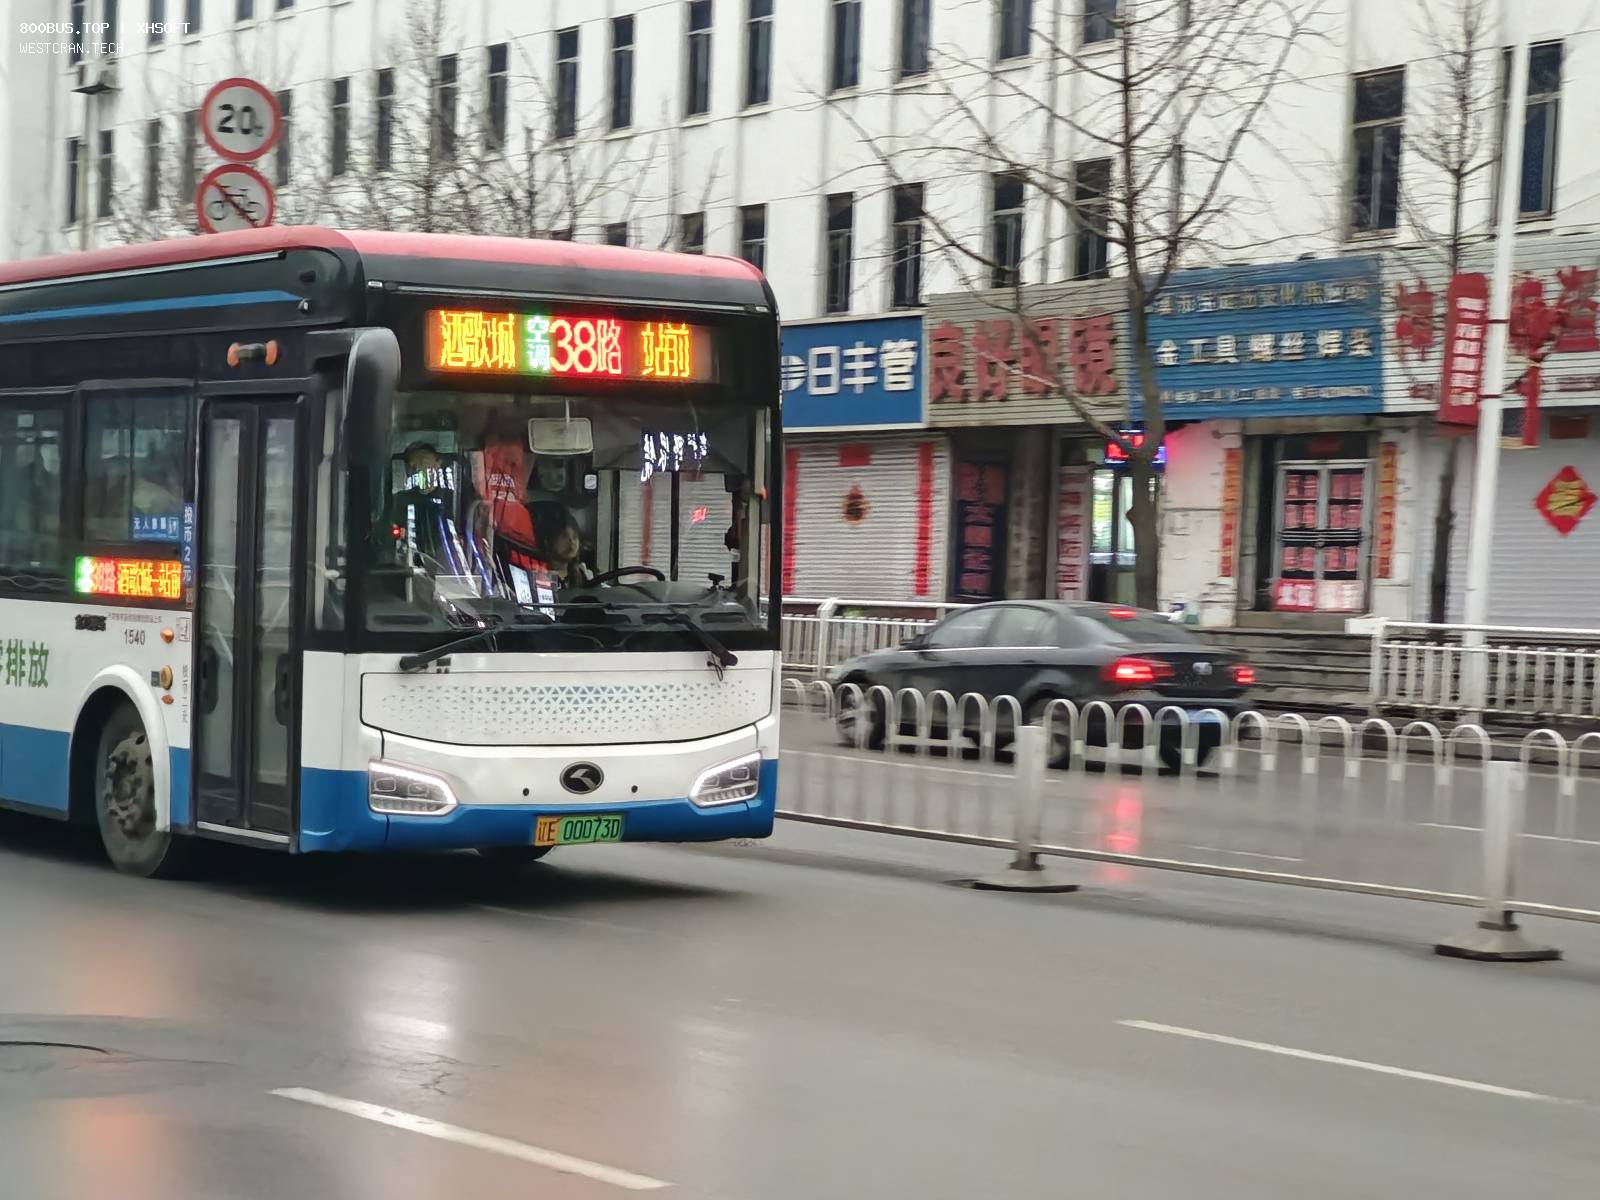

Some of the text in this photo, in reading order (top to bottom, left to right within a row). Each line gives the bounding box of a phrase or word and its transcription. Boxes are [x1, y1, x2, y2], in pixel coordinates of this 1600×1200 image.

[550, 318, 622, 375] 38路
[641, 322, 690, 378] 站前
[808, 339, 918, 395] 日丰管
[0, 638, 49, 688] 排放
[124, 628, 146, 646] 1540
